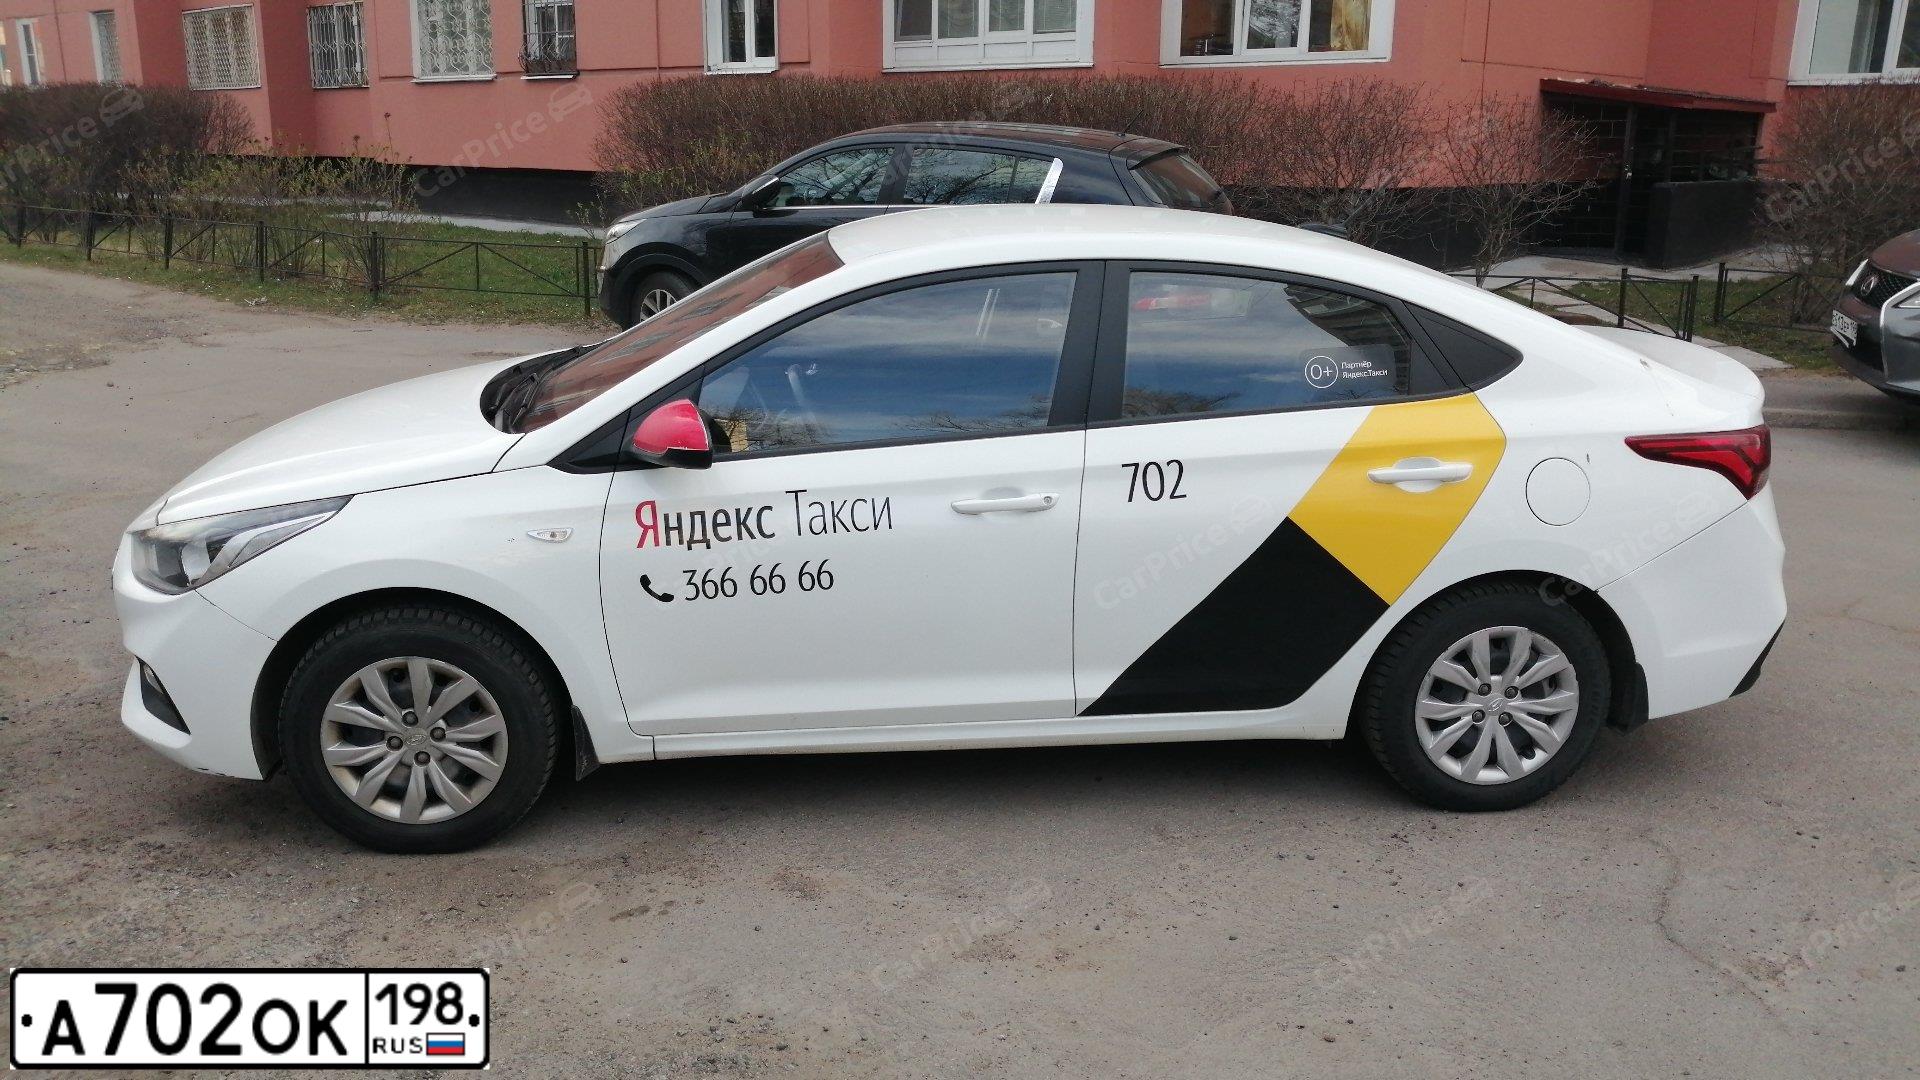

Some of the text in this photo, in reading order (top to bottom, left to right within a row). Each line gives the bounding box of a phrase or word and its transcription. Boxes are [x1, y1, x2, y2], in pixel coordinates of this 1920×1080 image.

[1341, 360, 1372, 370] Партнёр
[1342, 369, 1388, 379] Яндекс.Такси
[1121, 459, 1187, 502] 702
[634, 489, 893, 550] Яндекс Такси
[683, 558, 834, 601] 366 66 66
